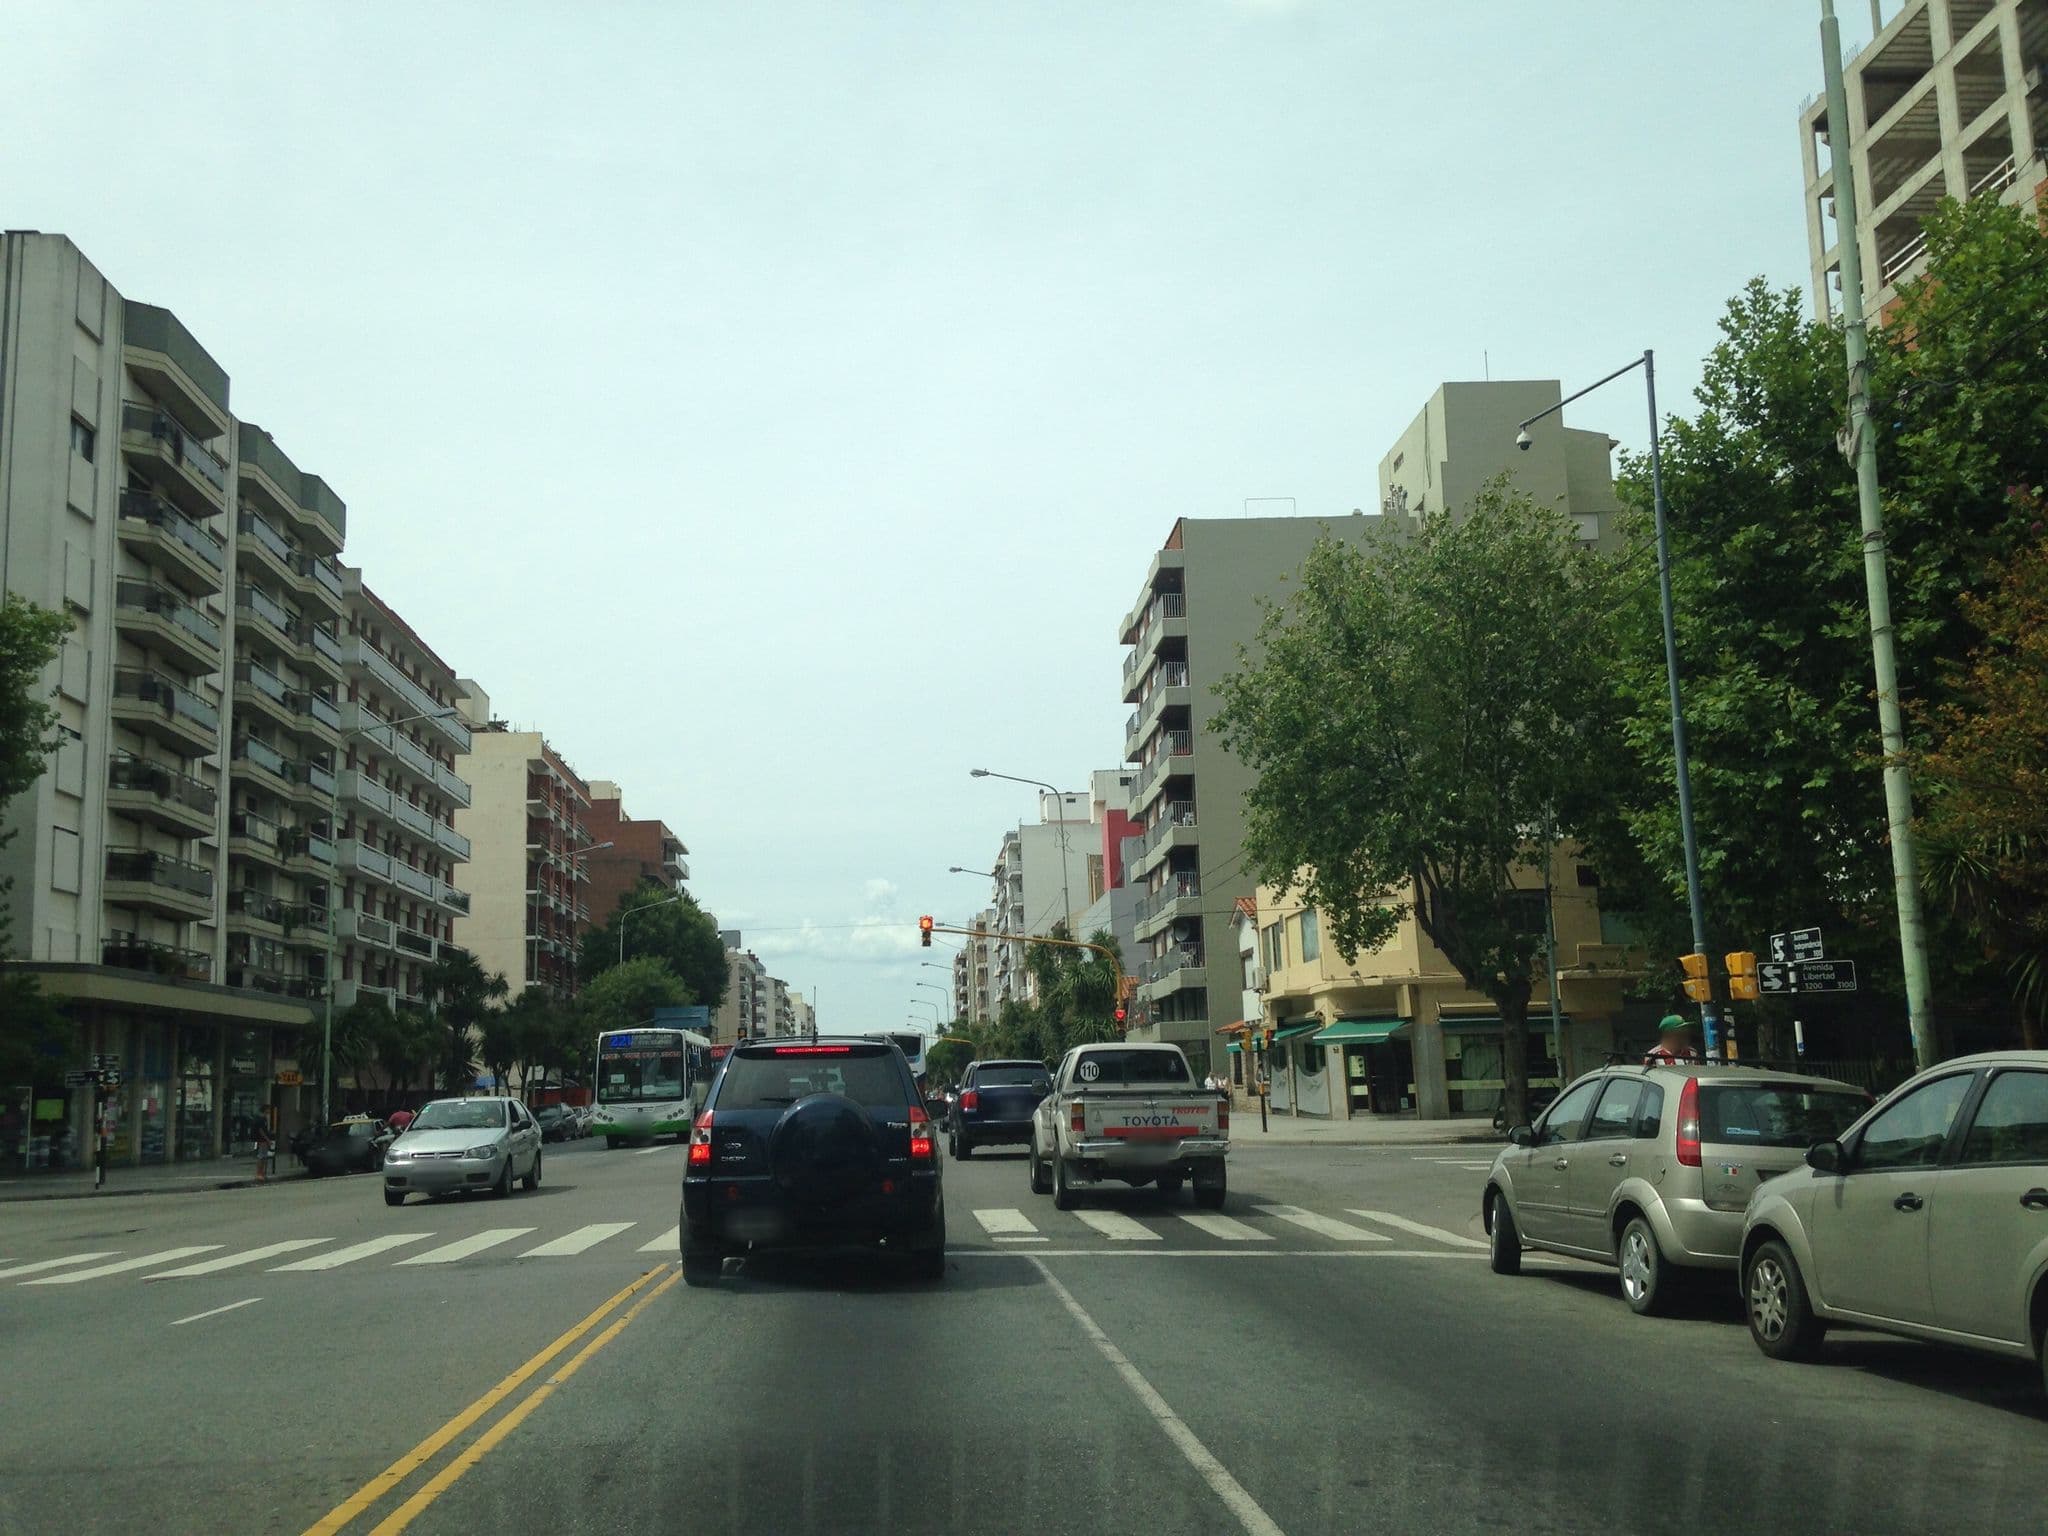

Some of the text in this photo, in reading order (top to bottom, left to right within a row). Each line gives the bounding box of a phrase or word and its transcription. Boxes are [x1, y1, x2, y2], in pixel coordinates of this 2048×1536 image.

[1802, 963, 1834, 971] Avenida
[1802, 972, 1835, 981] Libertad
[1837, 980, 1854, 989] 3100
[1081, 1064, 1099, 1078] 110
[1122, 1116, 1180, 1126] TOYOTA
